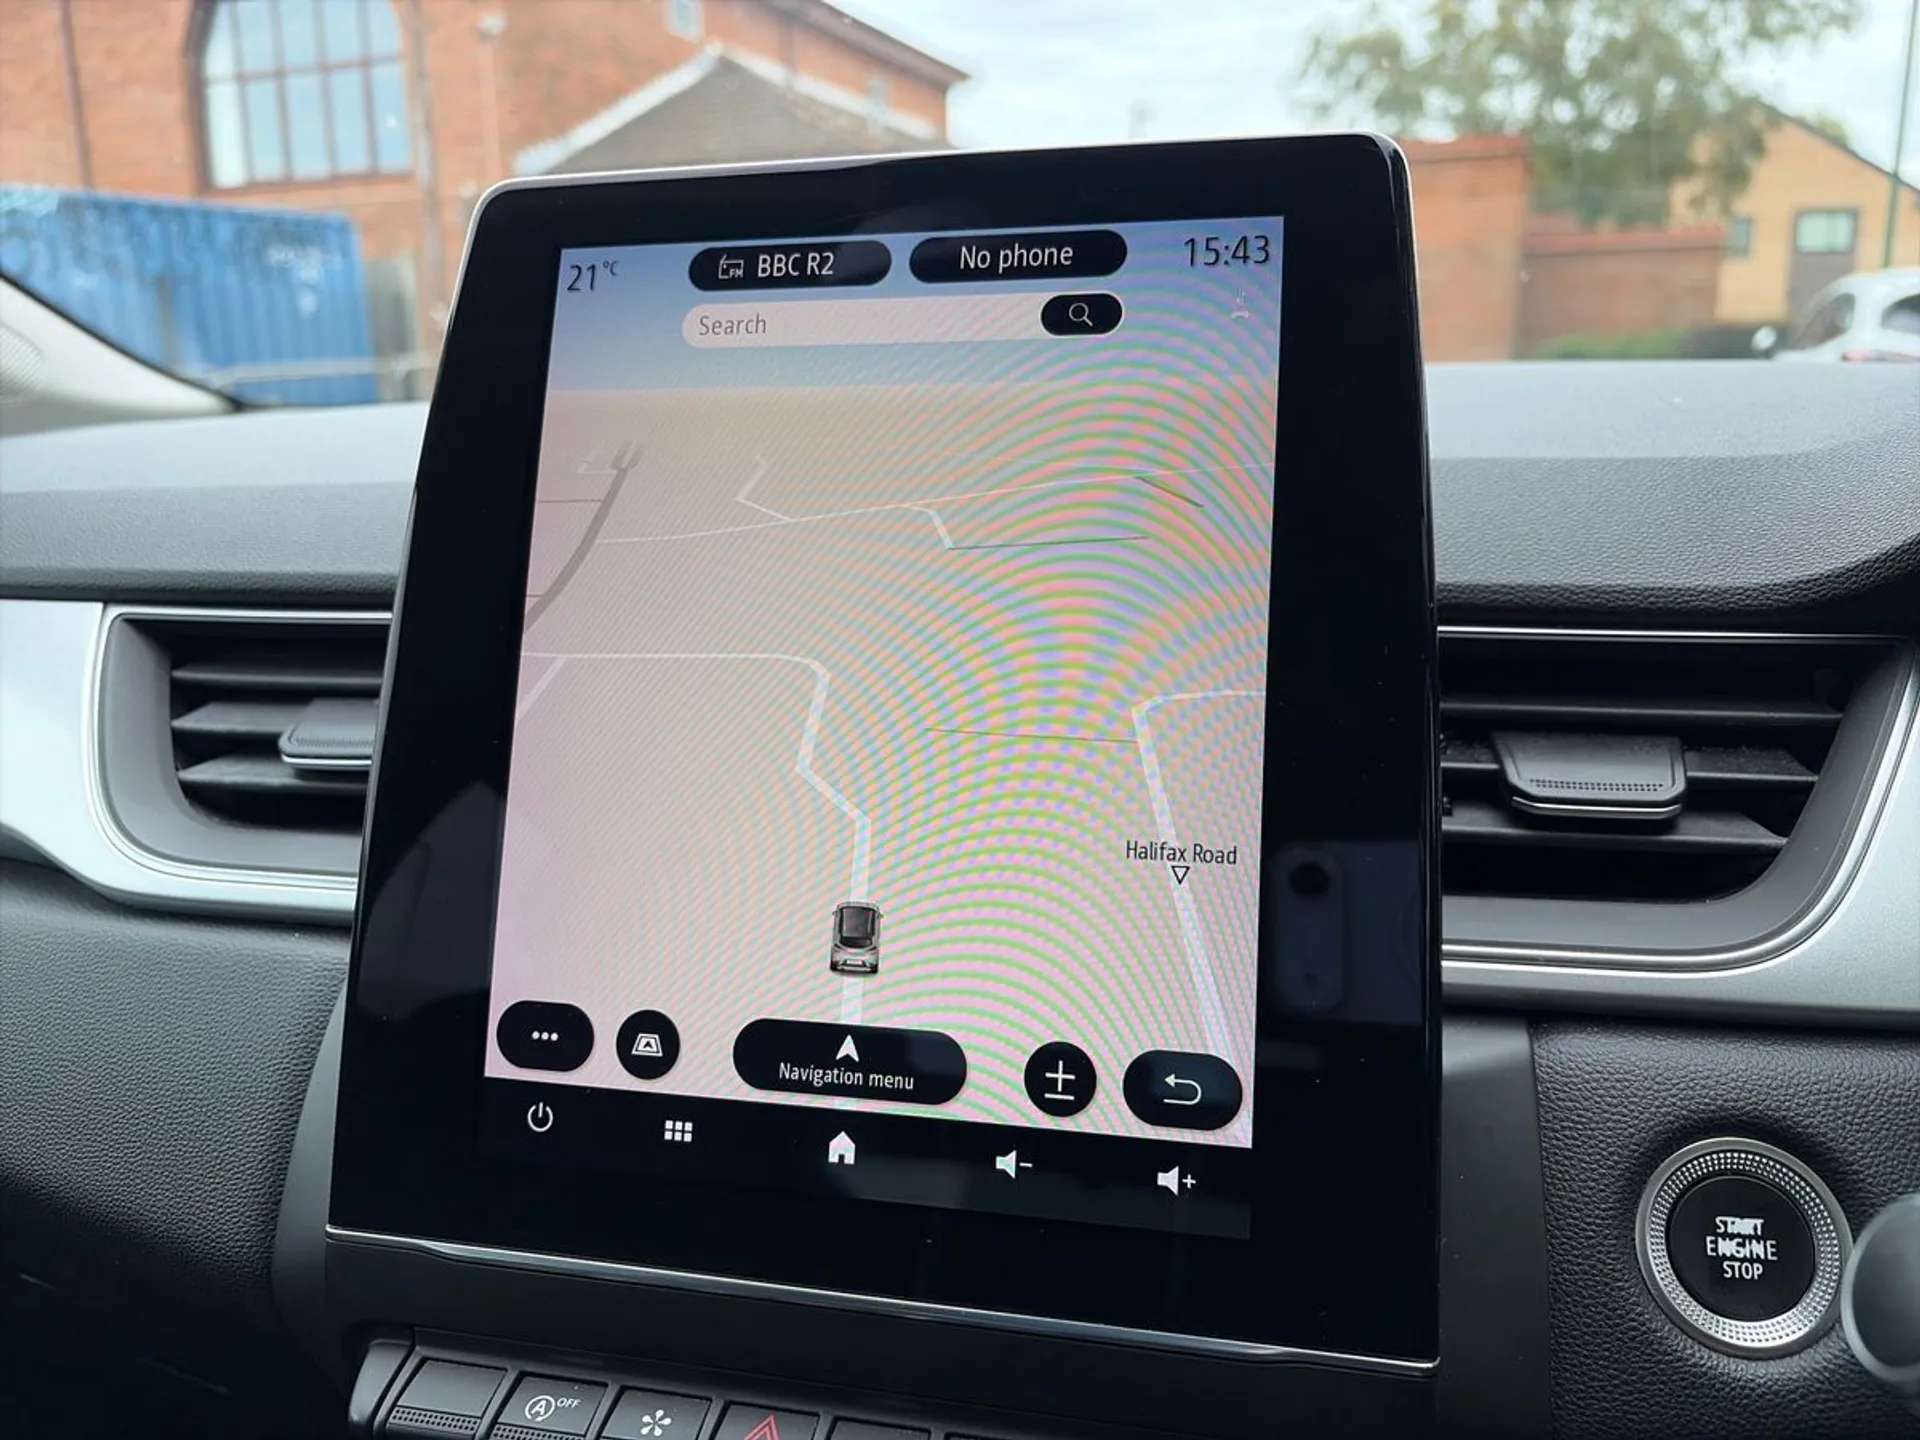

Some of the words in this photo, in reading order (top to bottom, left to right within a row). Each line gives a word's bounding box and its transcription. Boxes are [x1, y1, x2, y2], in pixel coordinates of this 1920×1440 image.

[959, 245, 991, 270] No
[998, 243, 1074, 274] phone
[1183, 234, 1270, 267] 15:43
[757, 253, 801, 278] BBC
[807, 252, 835, 276] R2
[699, 313, 767, 337] Search
[1126, 840, 1187, 862] Halifax
[1193, 843, 1237, 864] Road
[778, 1062, 863, 1088] Navigation
[868, 1072, 914, 1090] menu
[1706, 1236, 1778, 1260] ENGINE
[1723, 1261, 1763, 1280] STOP
[556, 1397, 582, 1408] OFF
